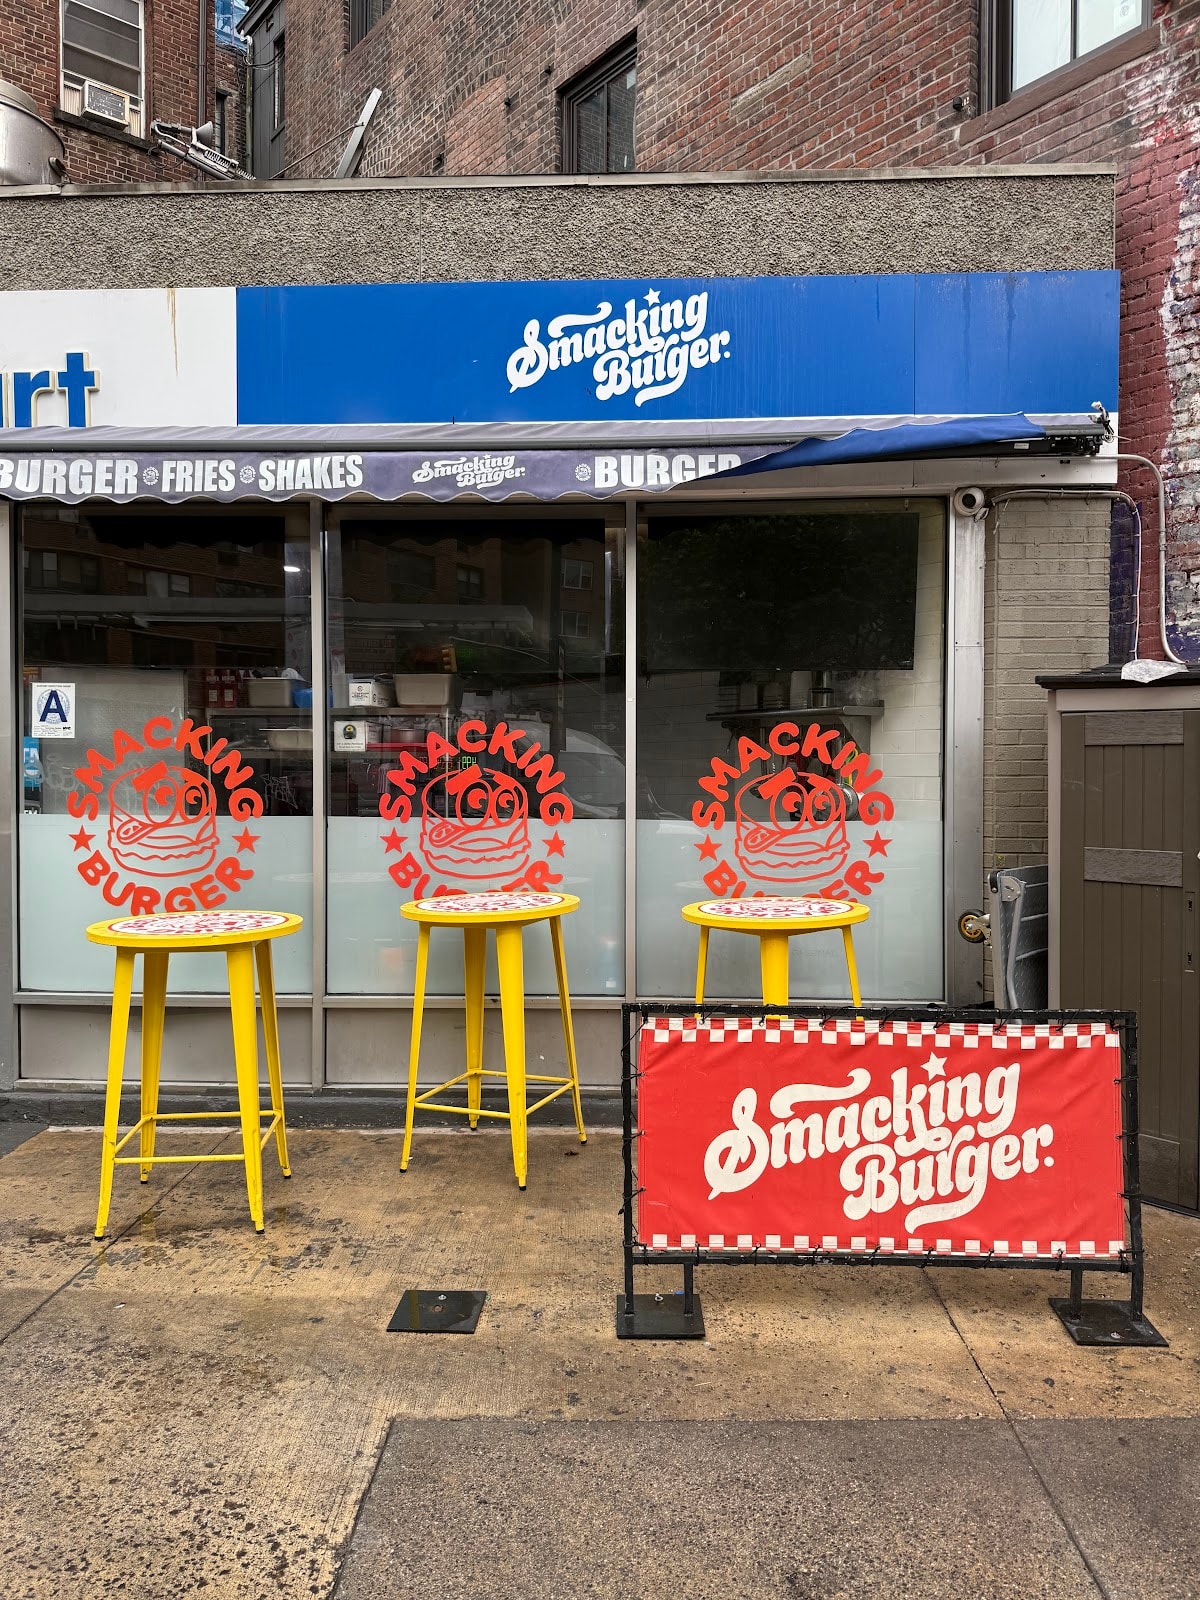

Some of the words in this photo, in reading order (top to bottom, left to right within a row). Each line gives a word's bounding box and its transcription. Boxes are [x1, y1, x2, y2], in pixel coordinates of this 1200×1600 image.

[507, 290, 708, 392] Smacking
[0, 352, 101, 428] rt
[161, 460, 235, 492] FRIES
[258, 455, 363, 491] SHAKES
[412, 454, 516, 483] Smacking
[39, 690, 67, 722] A
[68, 717, 262, 821] SMACKING
[380, 720, 573, 826] SMACKING
[692, 723, 894, 830] SMACKING
[78, 851, 254, 916] BURGER
[704, 1053, 1021, 1200] Smacking
